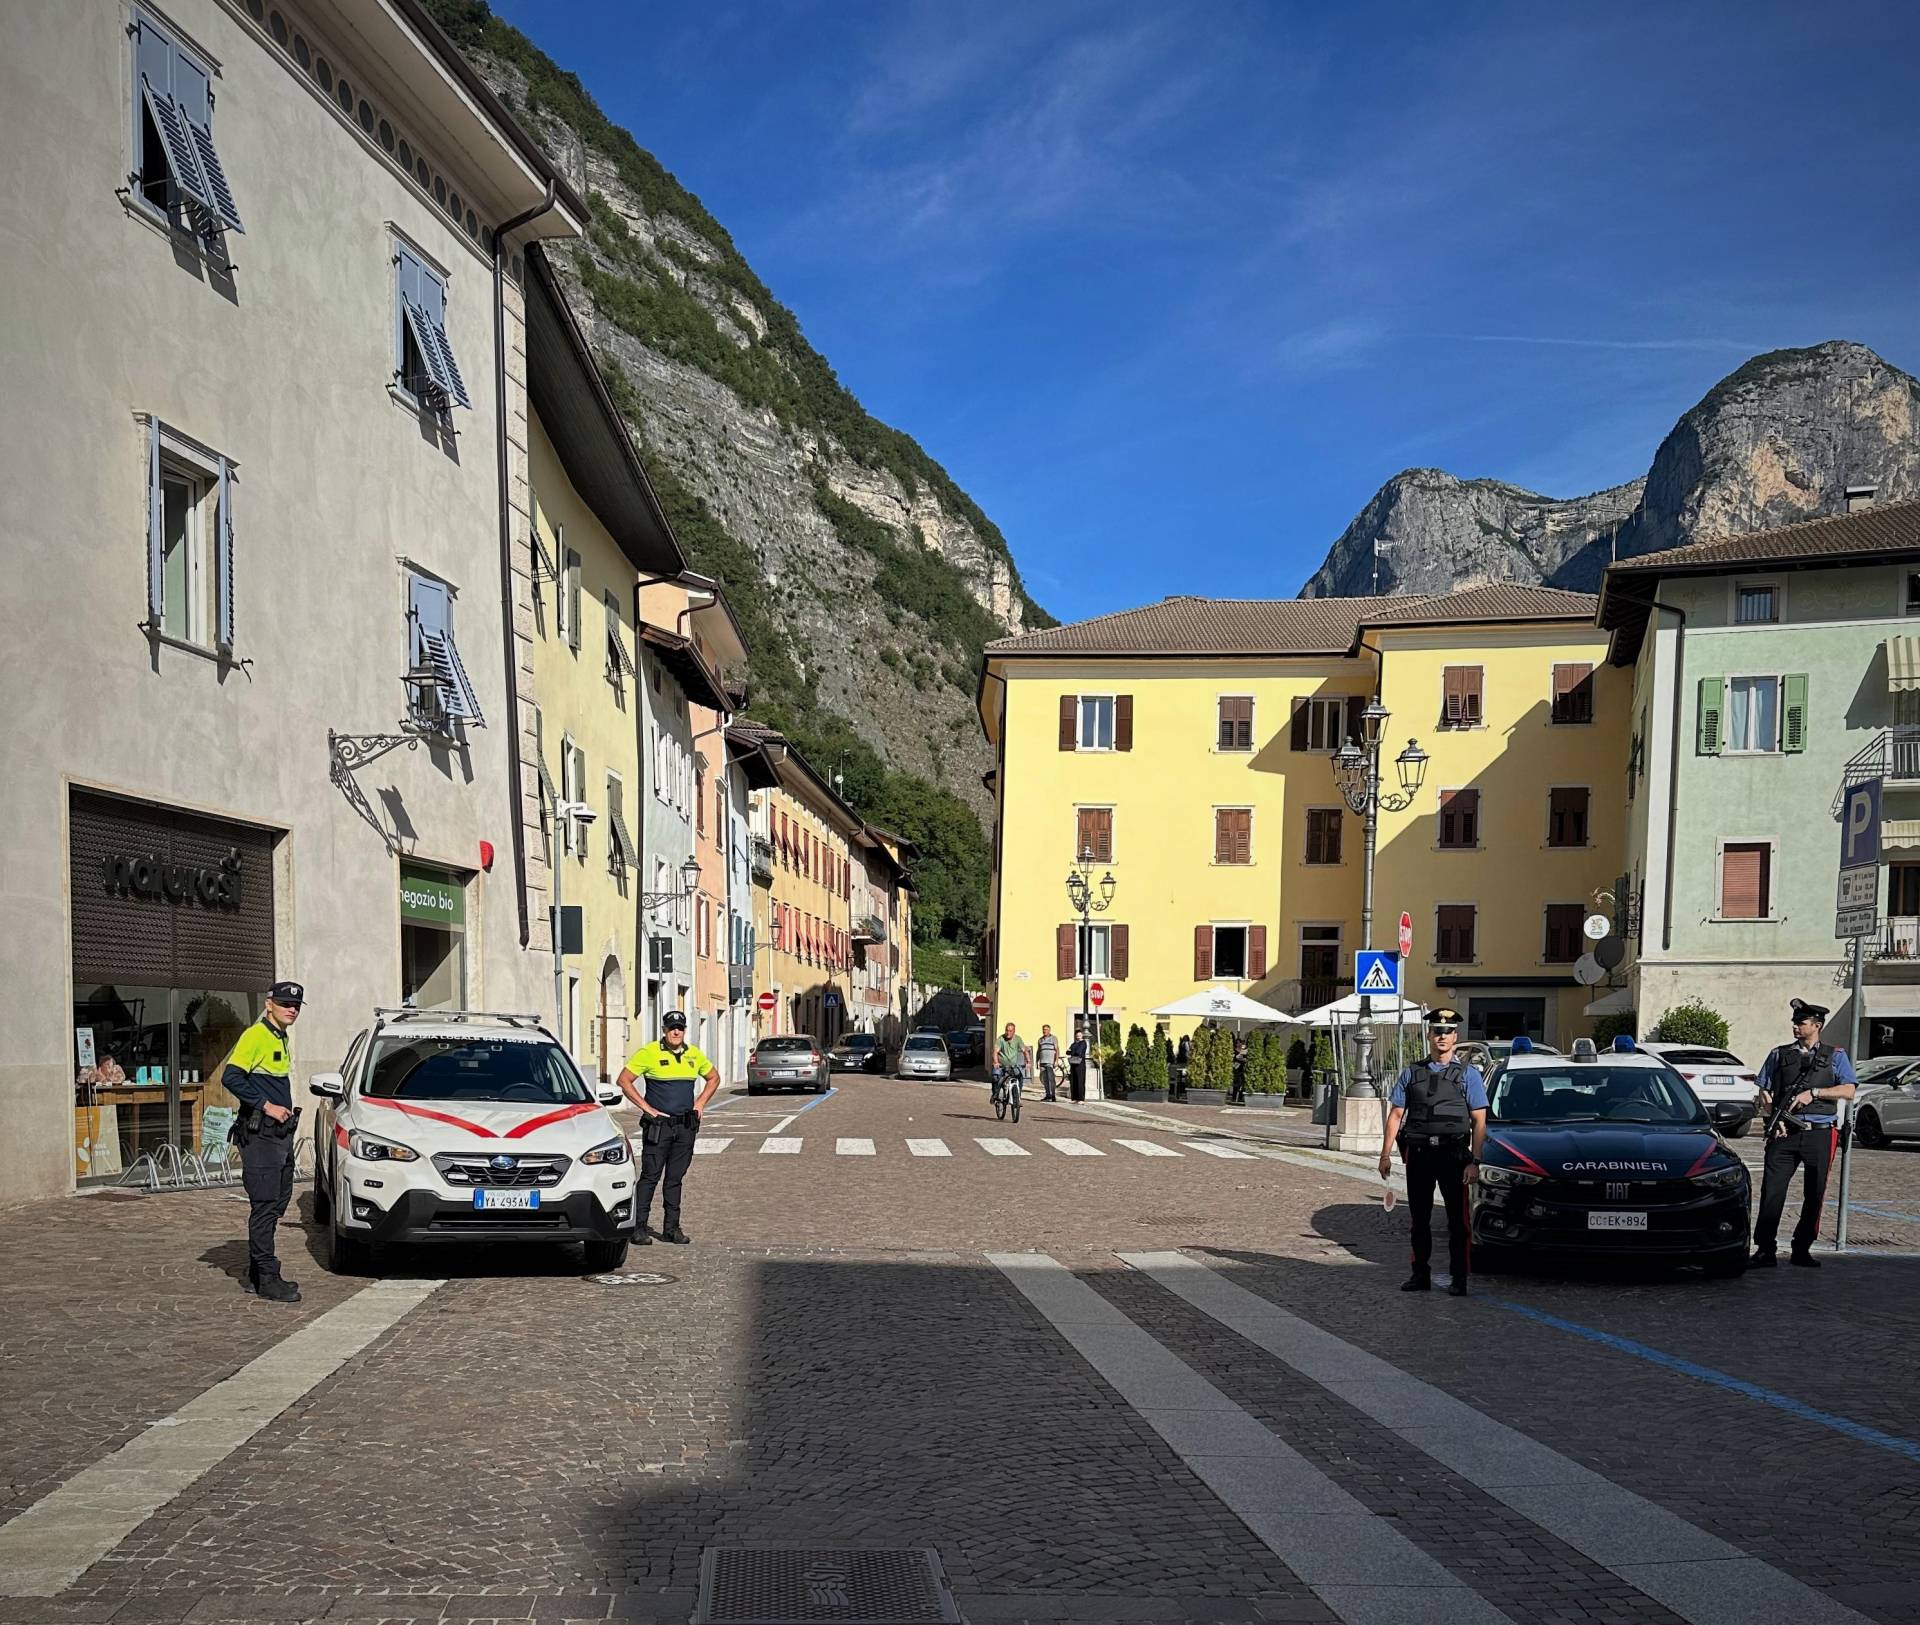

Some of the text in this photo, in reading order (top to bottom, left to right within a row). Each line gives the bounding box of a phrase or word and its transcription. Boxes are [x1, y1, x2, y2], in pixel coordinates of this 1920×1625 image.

[1848, 790, 1872, 857] P
[439, 890, 454, 911] bio
[1091, 989, 1104, 999] STOP
[1562, 1161, 1668, 1171] CARABINIERI
[1606, 1182, 1631, 1200] FIAT
